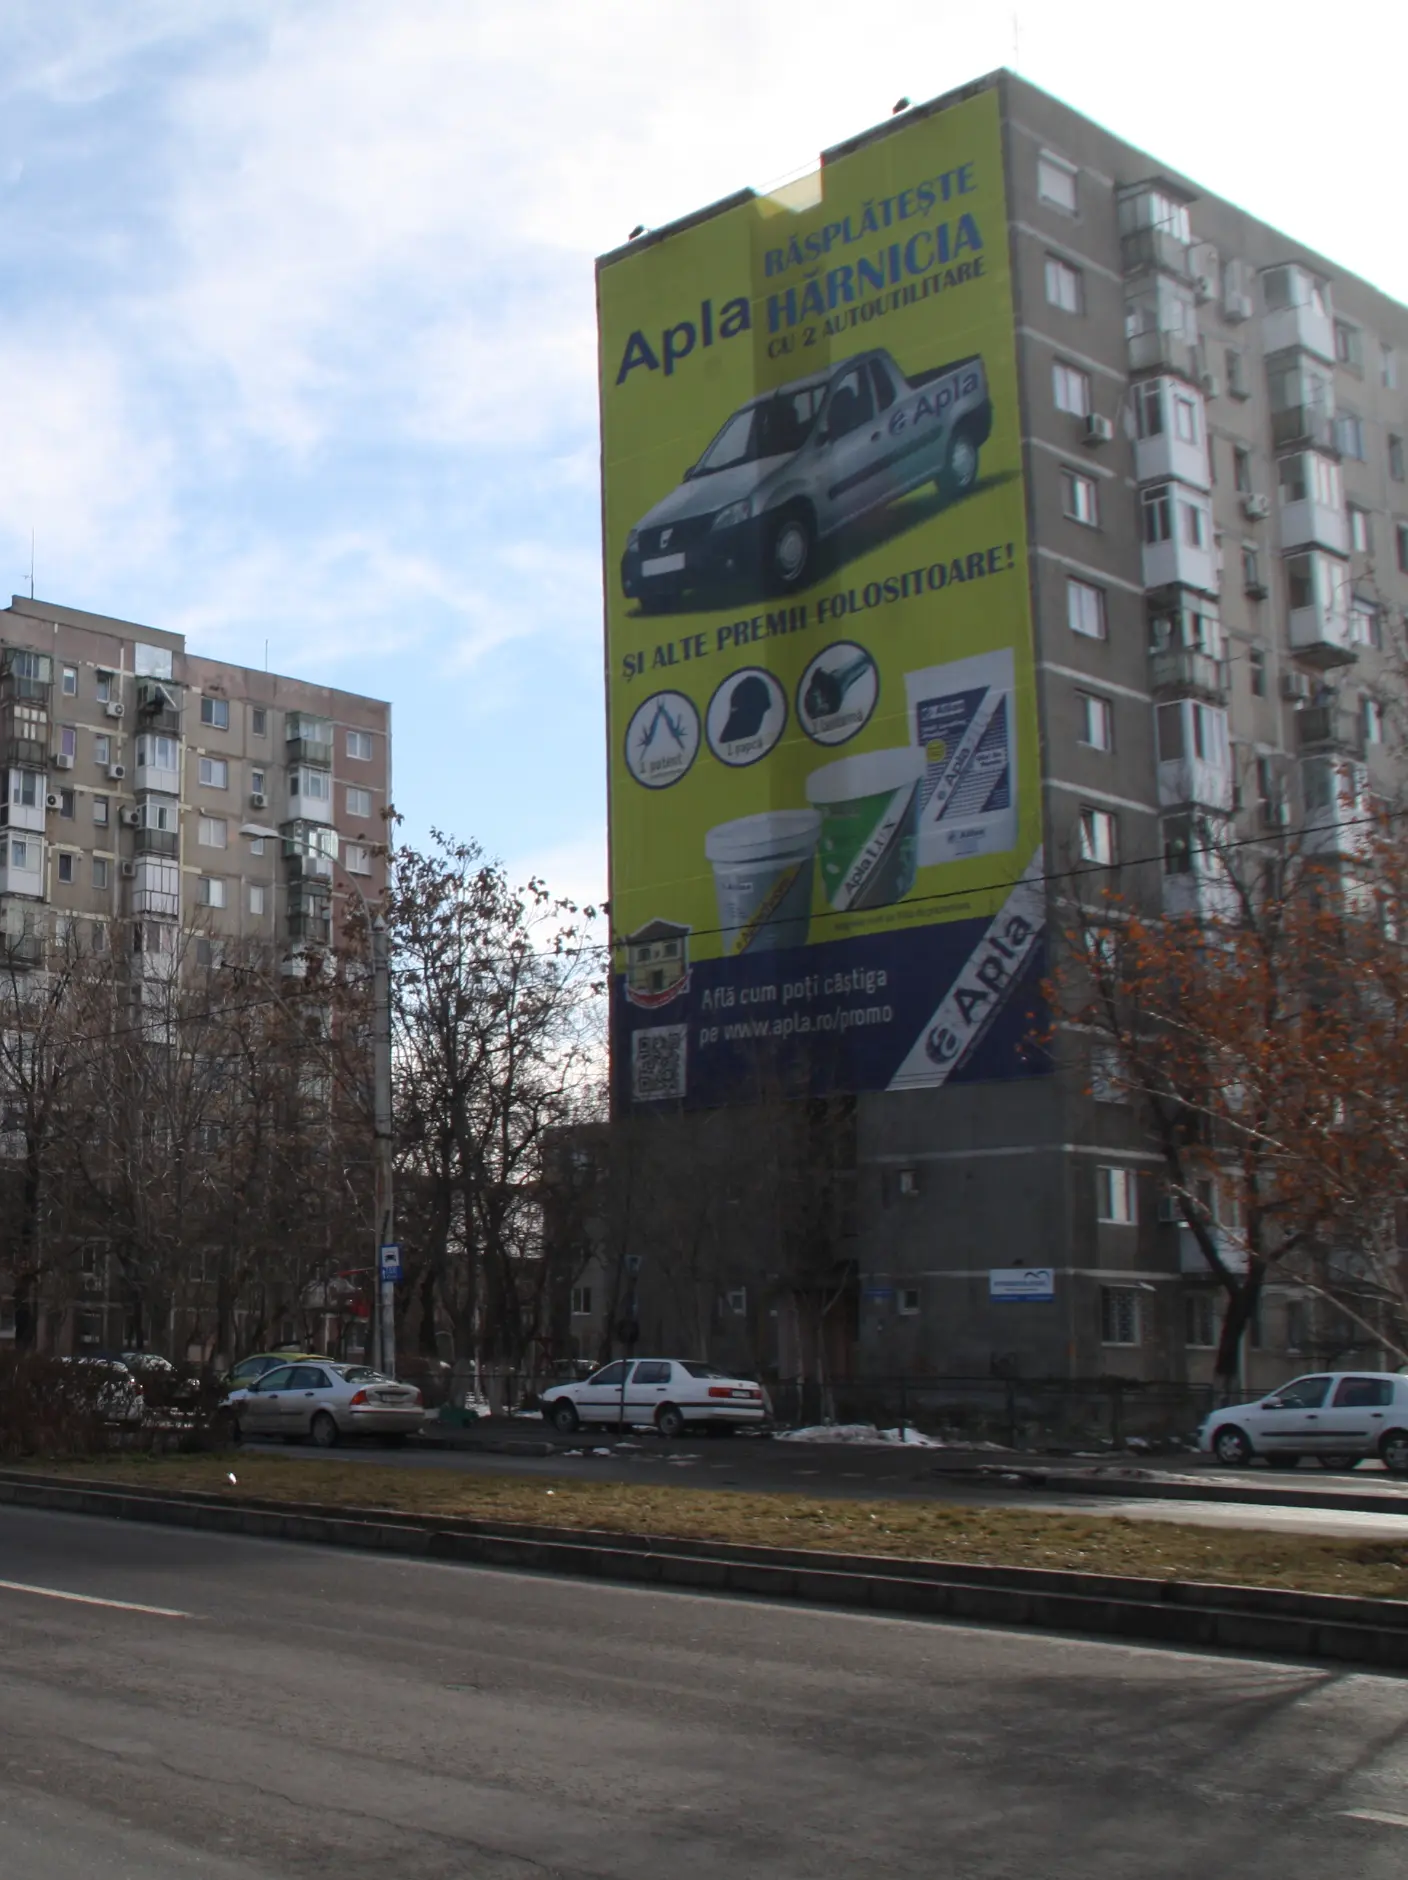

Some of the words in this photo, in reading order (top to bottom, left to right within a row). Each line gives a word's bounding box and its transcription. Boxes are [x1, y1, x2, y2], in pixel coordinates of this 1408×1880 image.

[764, 161, 978, 279] RĂSPLĂTEȘTE
[767, 211, 984, 334] HĂRNICIA
[767, 332, 796, 359] CU
[803, 326, 817, 347] 2
[823, 256, 987, 336] AUTOUTILITARE
[615, 296, 751, 386] Apla
[912, 372, 979, 426] Apla
[622, 651, 645, 681] ȘI
[652, 629, 708, 670] ALTE
[717, 606, 807, 651] PREMII
[817, 542, 1016, 624] FOLOSITOARE!
[844, 859, 872, 896] Apla
[701, 984, 735, 1012] Află
[740, 984, 777, 1004] cum
[782, 974, 819, 1006] poți
[824, 967, 888, 999] câștiga
[953, 914, 1031, 1026] Apla
[699, 1026, 718, 1049] pe
[723, 1005, 893, 1041] www.apla.ro/promo
